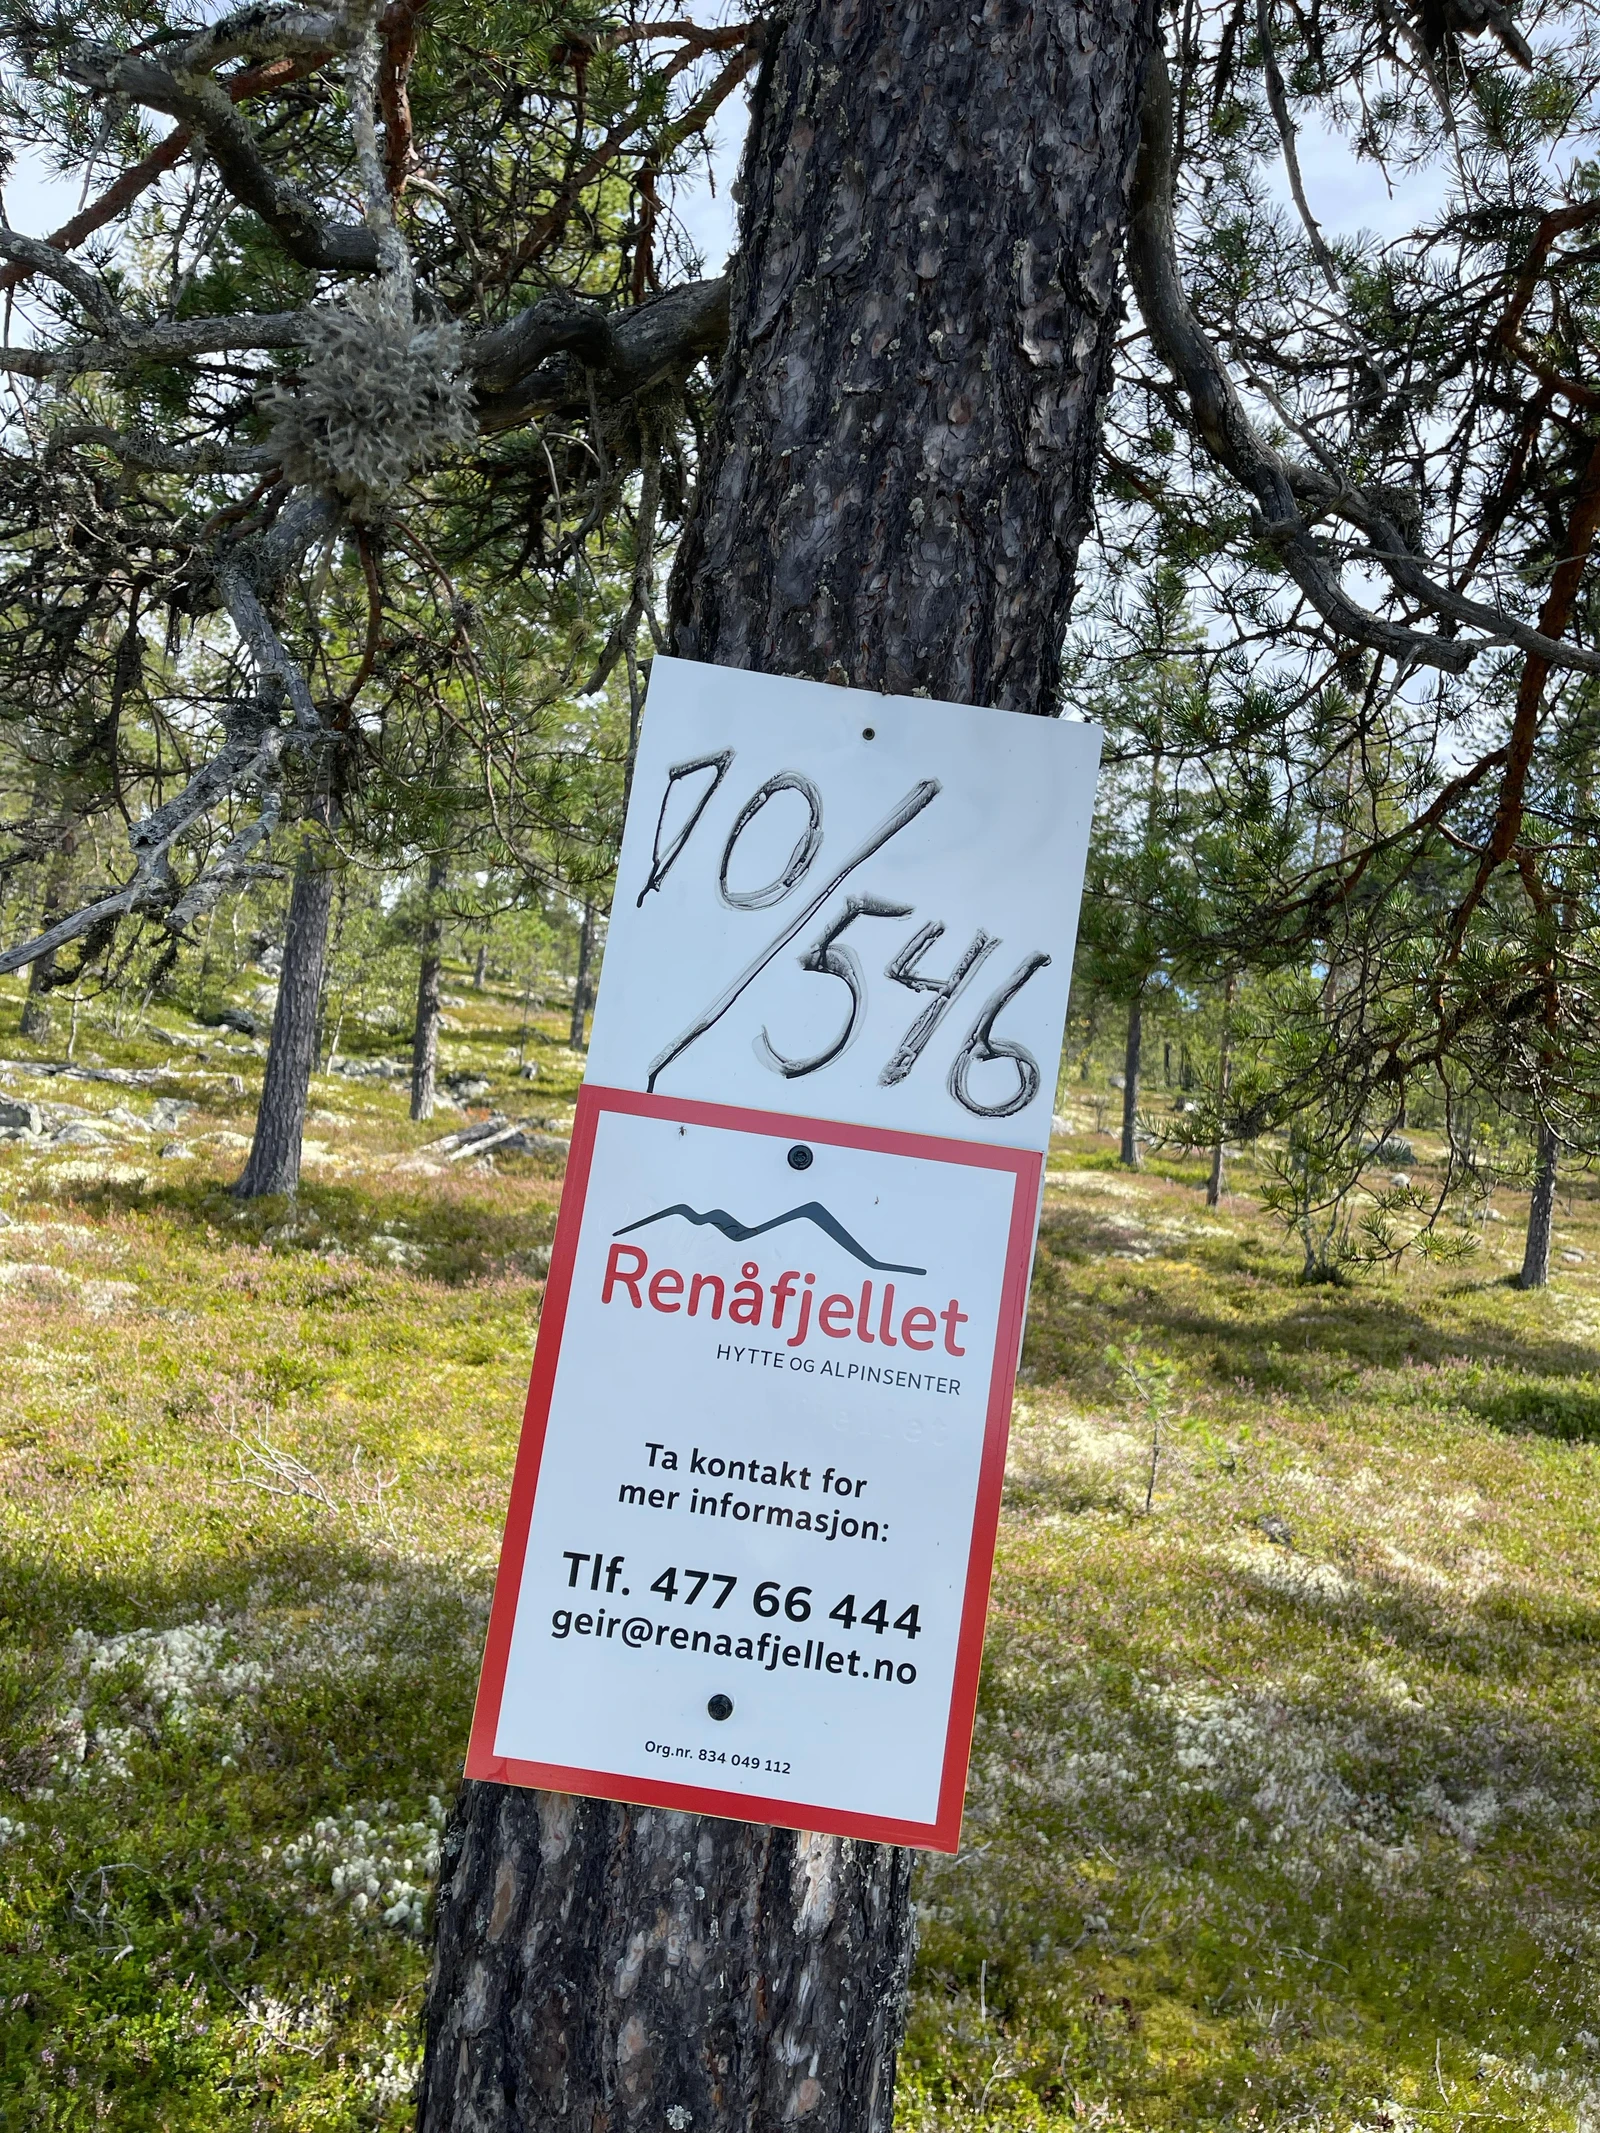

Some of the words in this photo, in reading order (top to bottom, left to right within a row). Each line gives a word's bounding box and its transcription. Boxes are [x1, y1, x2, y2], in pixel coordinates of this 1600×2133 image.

[752, 892, 1052, 1119] 546
[600, 1243, 970, 1358] Renåfjellet
[716, 1343, 786, 1370] HYTTE
[789, 1356, 816, 1374] OG
[819, 1359, 961, 1396] ALPINSENTER
[644, 1442, 678, 1471] Ta
[689, 1447, 812, 1492] kontakt
[822, 1467, 868, 1499] for
[618, 1484, 681, 1510] mer
[689, 1487, 890, 1543] informasjon:
[562, 1550, 630, 1597] Tlf.
[649, 1566, 738, 1610] 477
[752, 1581, 813, 1623] 66
[828, 1593, 922, 1640] 444
[551, 1607, 918, 1686] geir@renaafjellet.no
[644, 1740, 694, 1760] Org.nr.
[698, 1748, 727, 1764] 834
[730, 1754, 761, 1770] 049
[764, 1759, 791, 1775] 112
